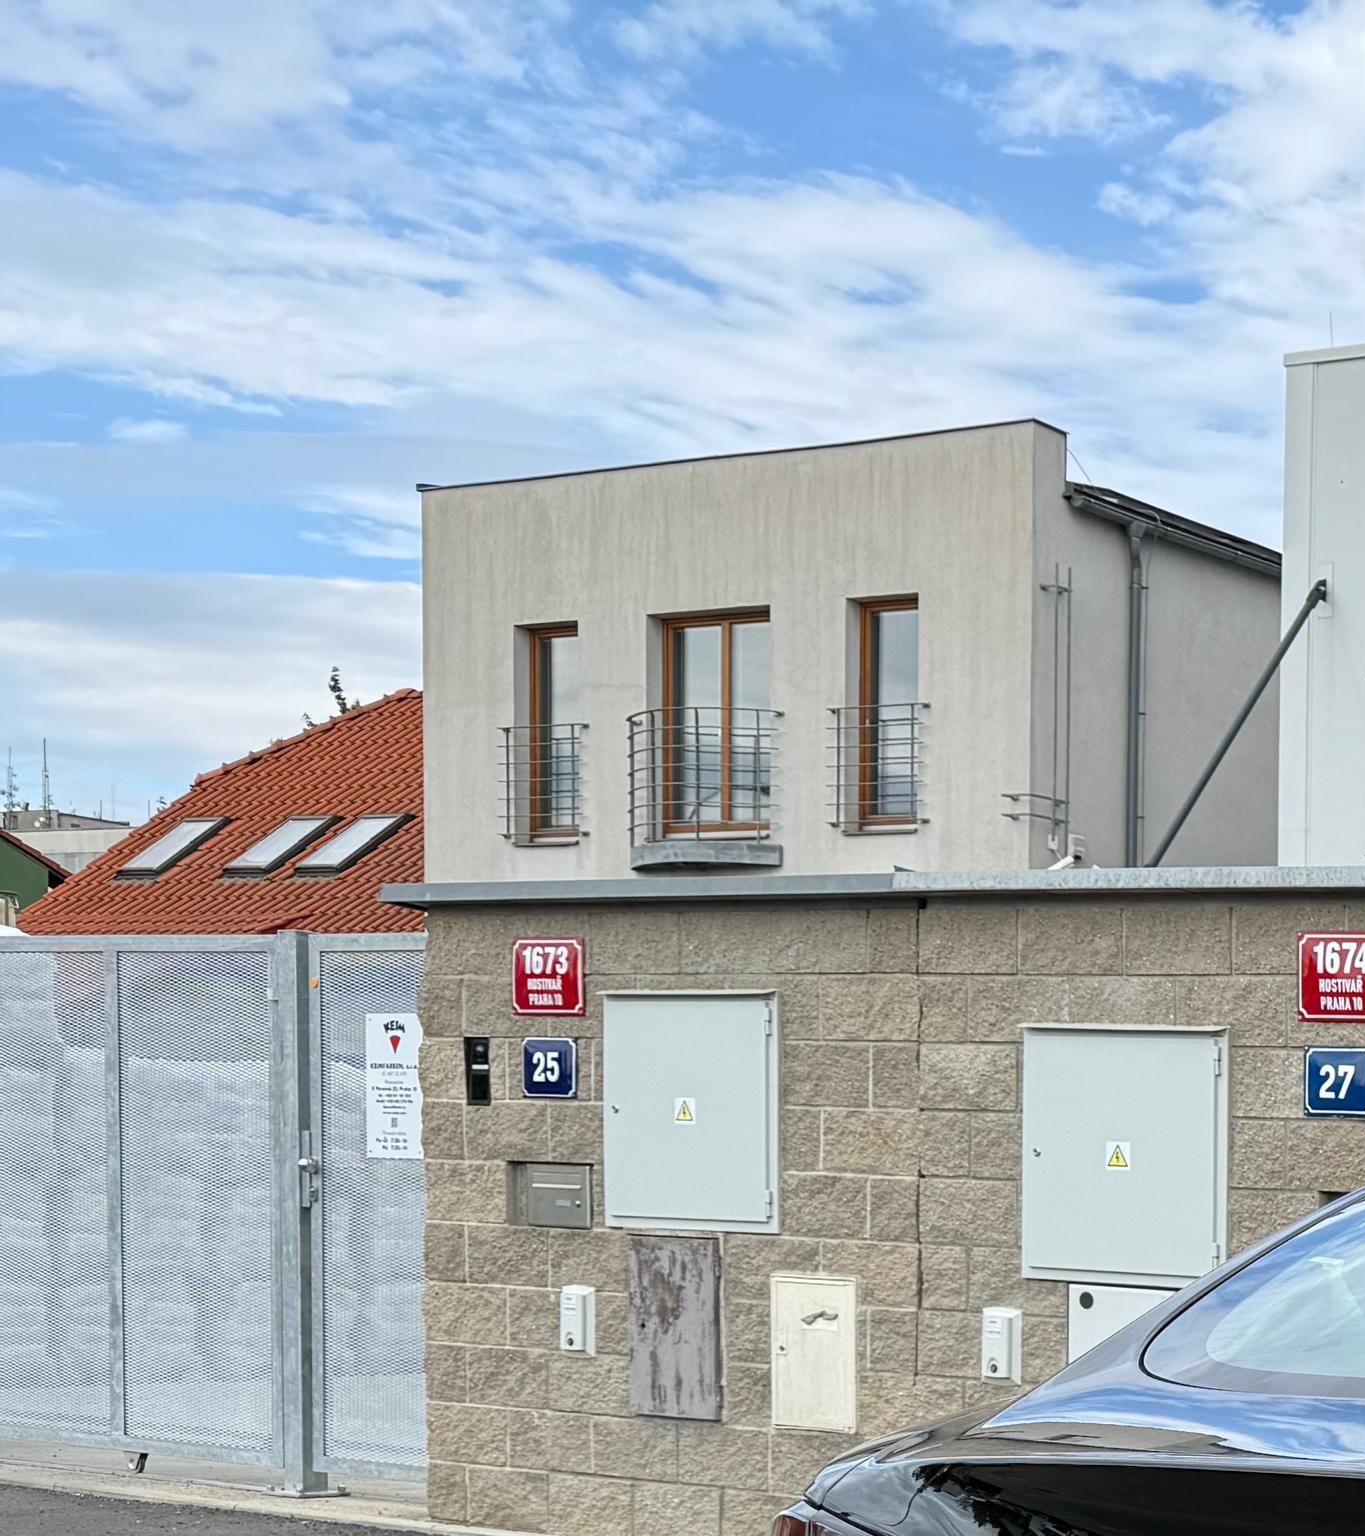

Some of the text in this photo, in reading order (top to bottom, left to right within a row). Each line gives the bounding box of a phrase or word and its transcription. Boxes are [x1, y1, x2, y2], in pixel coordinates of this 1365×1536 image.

[522, 946, 569, 974] 1673
[1318, 975, 1363, 993] HOSTIVAŘ
[1320, 996, 1363, 1011] PRAHA 10
[383, 1020, 406, 1034] KEIM
[532, 1051, 560, 1083] 25
[1319, 1064, 1356, 1099] 27
